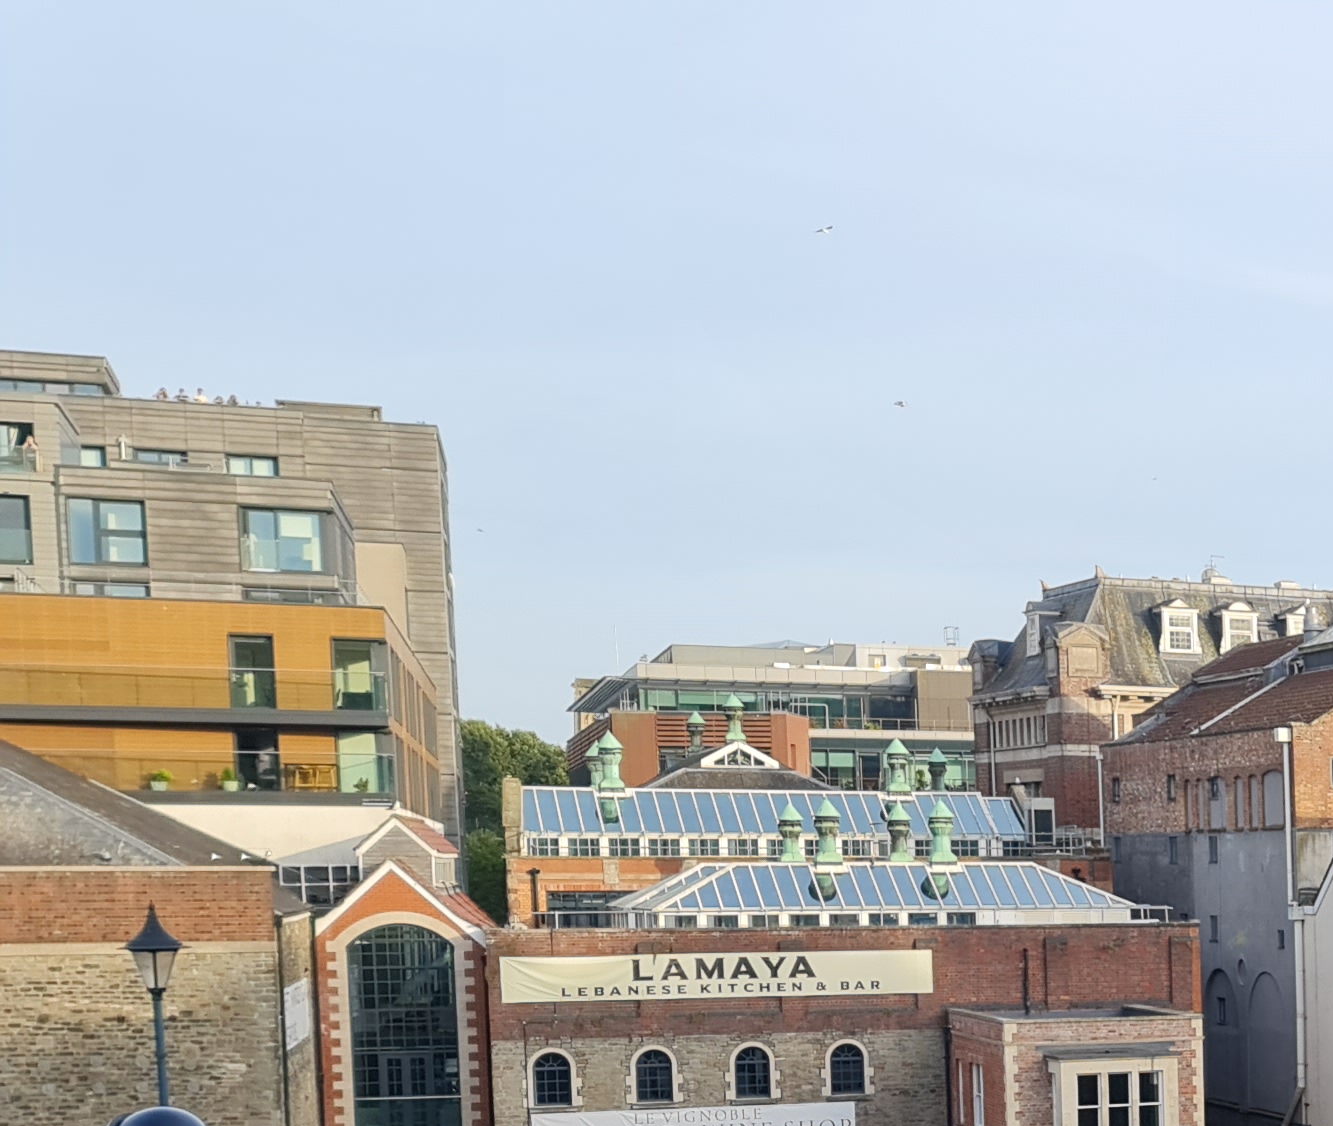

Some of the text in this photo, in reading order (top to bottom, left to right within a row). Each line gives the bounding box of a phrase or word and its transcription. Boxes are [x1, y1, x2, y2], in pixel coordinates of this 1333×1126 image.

[631, 956, 817, 982] LAMAYA
[561, 980, 882, 998] LEBANESE KITCHEN & BAR
[633, 1108, 763, 1125] LE VIGNOBLE
